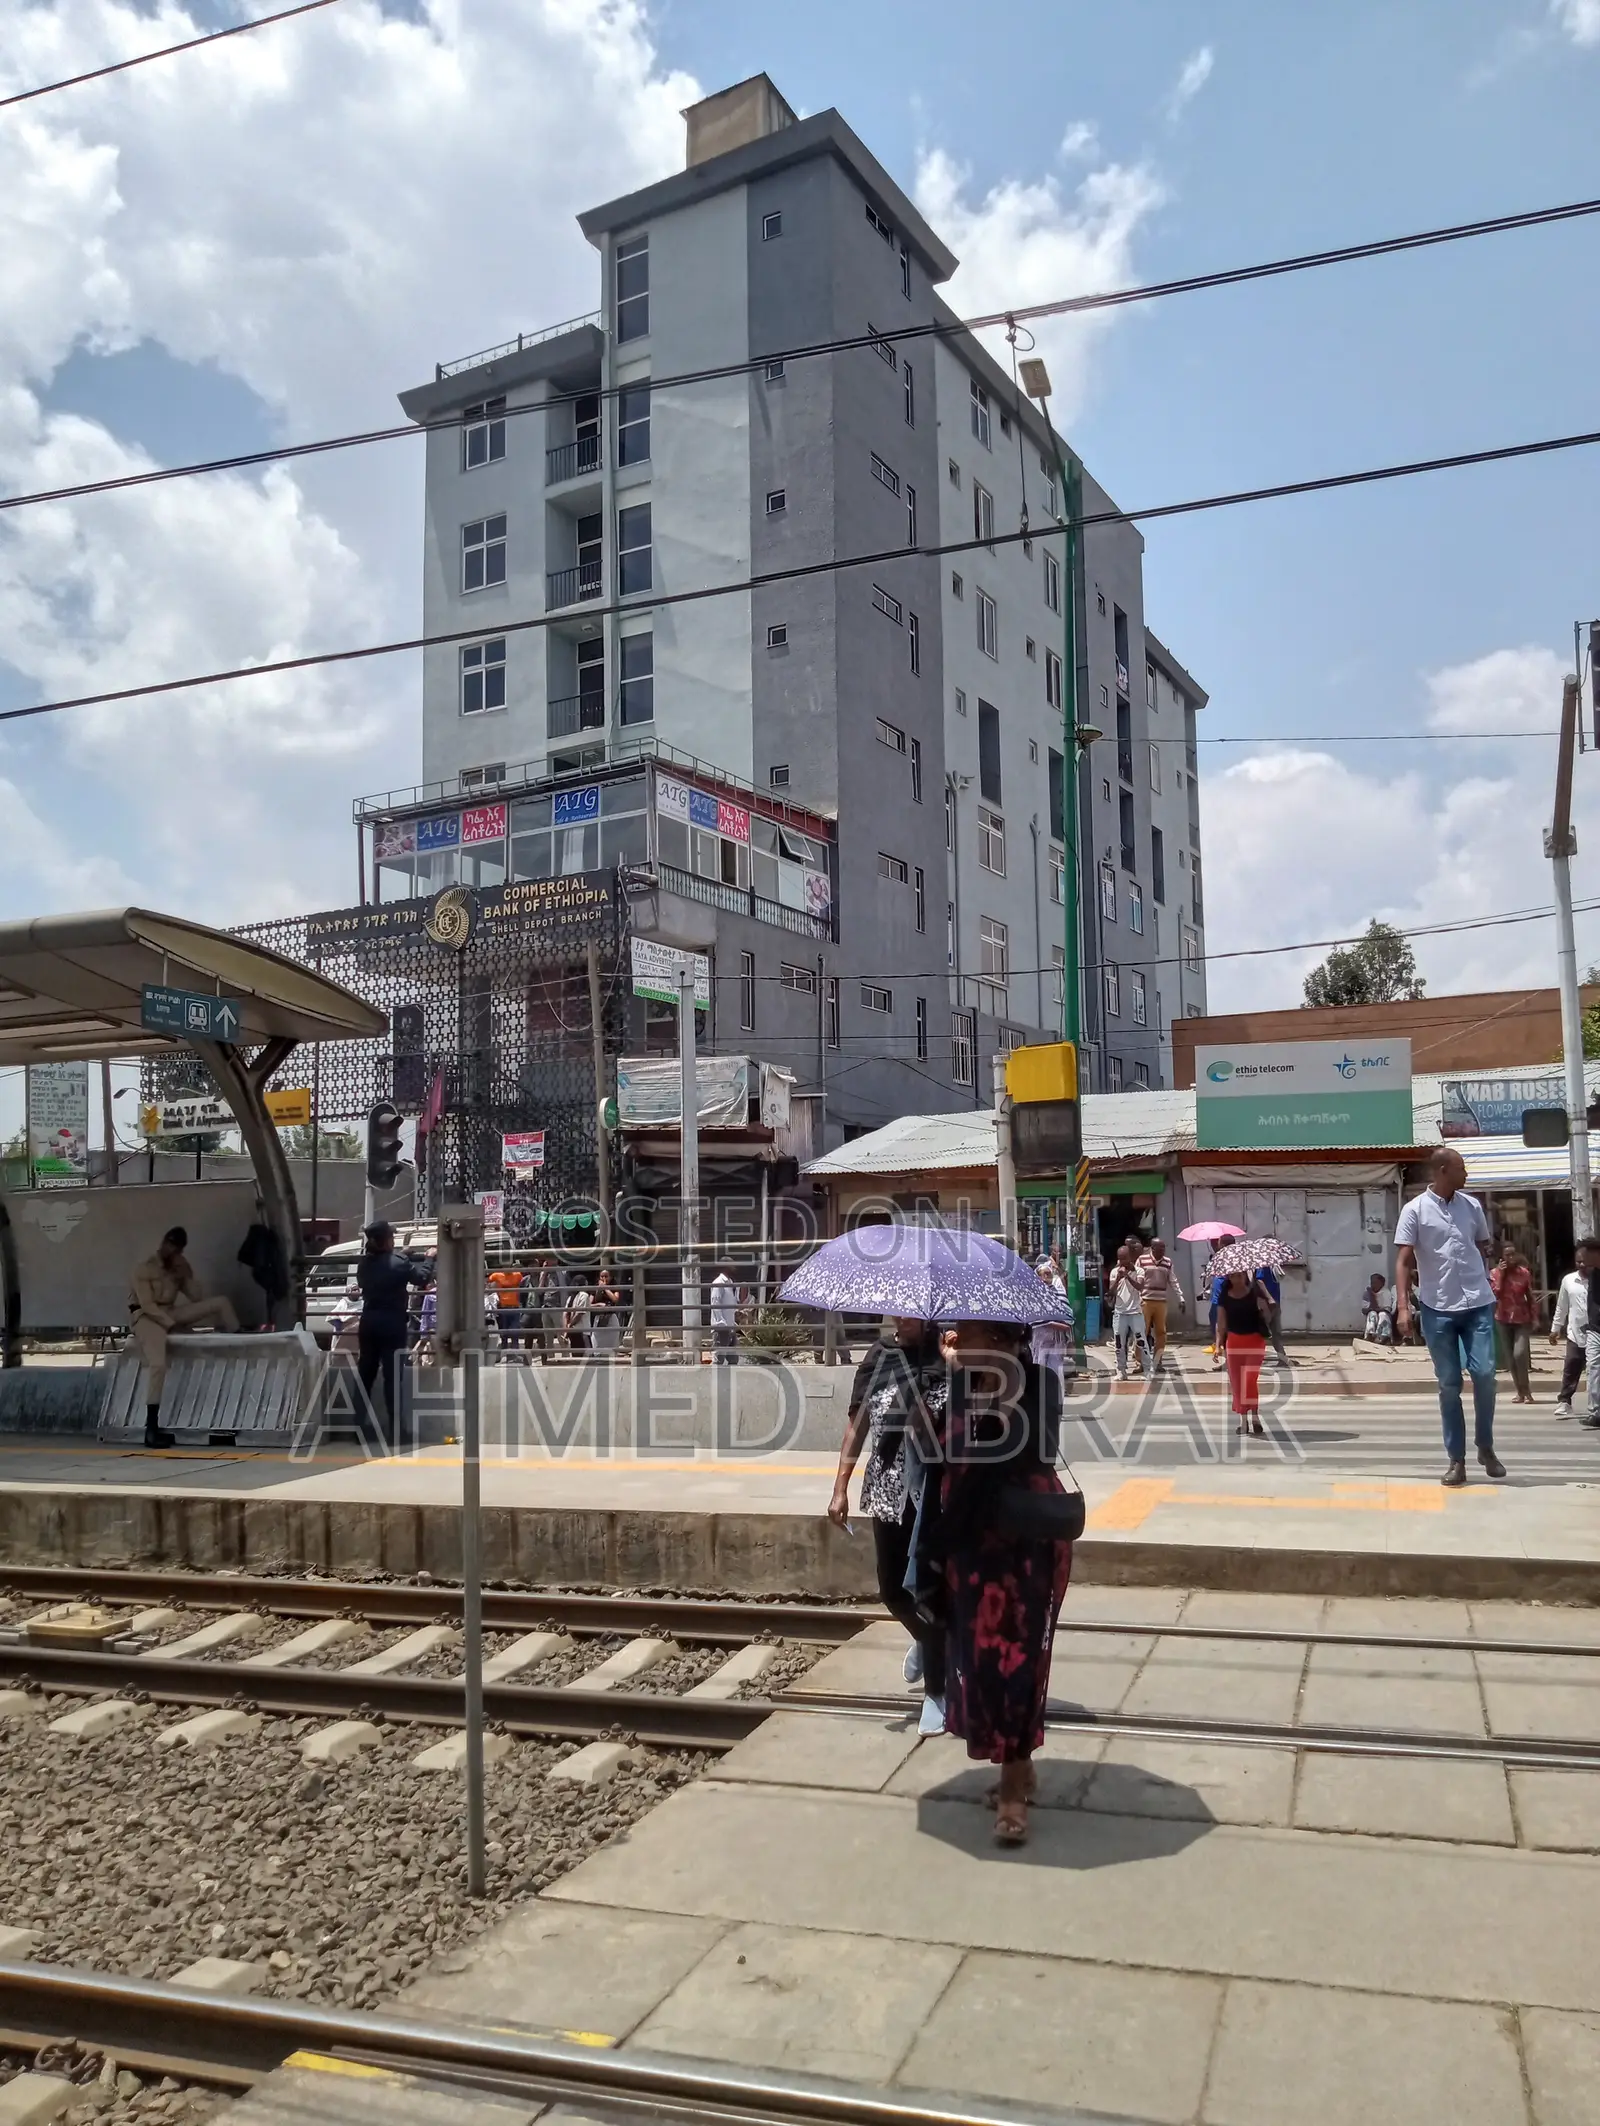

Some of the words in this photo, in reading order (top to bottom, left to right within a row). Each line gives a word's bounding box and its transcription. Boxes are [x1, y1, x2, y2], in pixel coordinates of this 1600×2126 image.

[555, 788, 598, 813] ATG
[658, 782, 688, 808] ATG
[486, 807, 500, 821] እና
[690, 794, 717, 820] ATG
[735, 808, 745, 824] እና
[418, 817, 458, 840] ATG
[463, 820, 505, 841] ሬስቶራንት
[503, 877, 588, 901] COMMERCIAL
[483, 902, 520, 919] BANK
[524, 899, 541, 912] OF
[545, 889, 609, 910] ETHIOPIA
[309, 917, 359, 935] የኢትዮጵያ
[363, 913, 389, 929] ንግድ
[393, 910, 418, 924] ባንክ
[491, 923, 519, 935] SHELL
[525, 917, 555, 930] DEPOT
[561, 910, 602, 924] BRANCH
[1235, 1064, 1258, 1075] ethio
[1259, 1063, 1295, 1074] telecom
[1477, 1103, 1513, 1118] FLOWER
[163, 1117, 183, 1130] Bank
[186, 1115, 195, 1128] of
